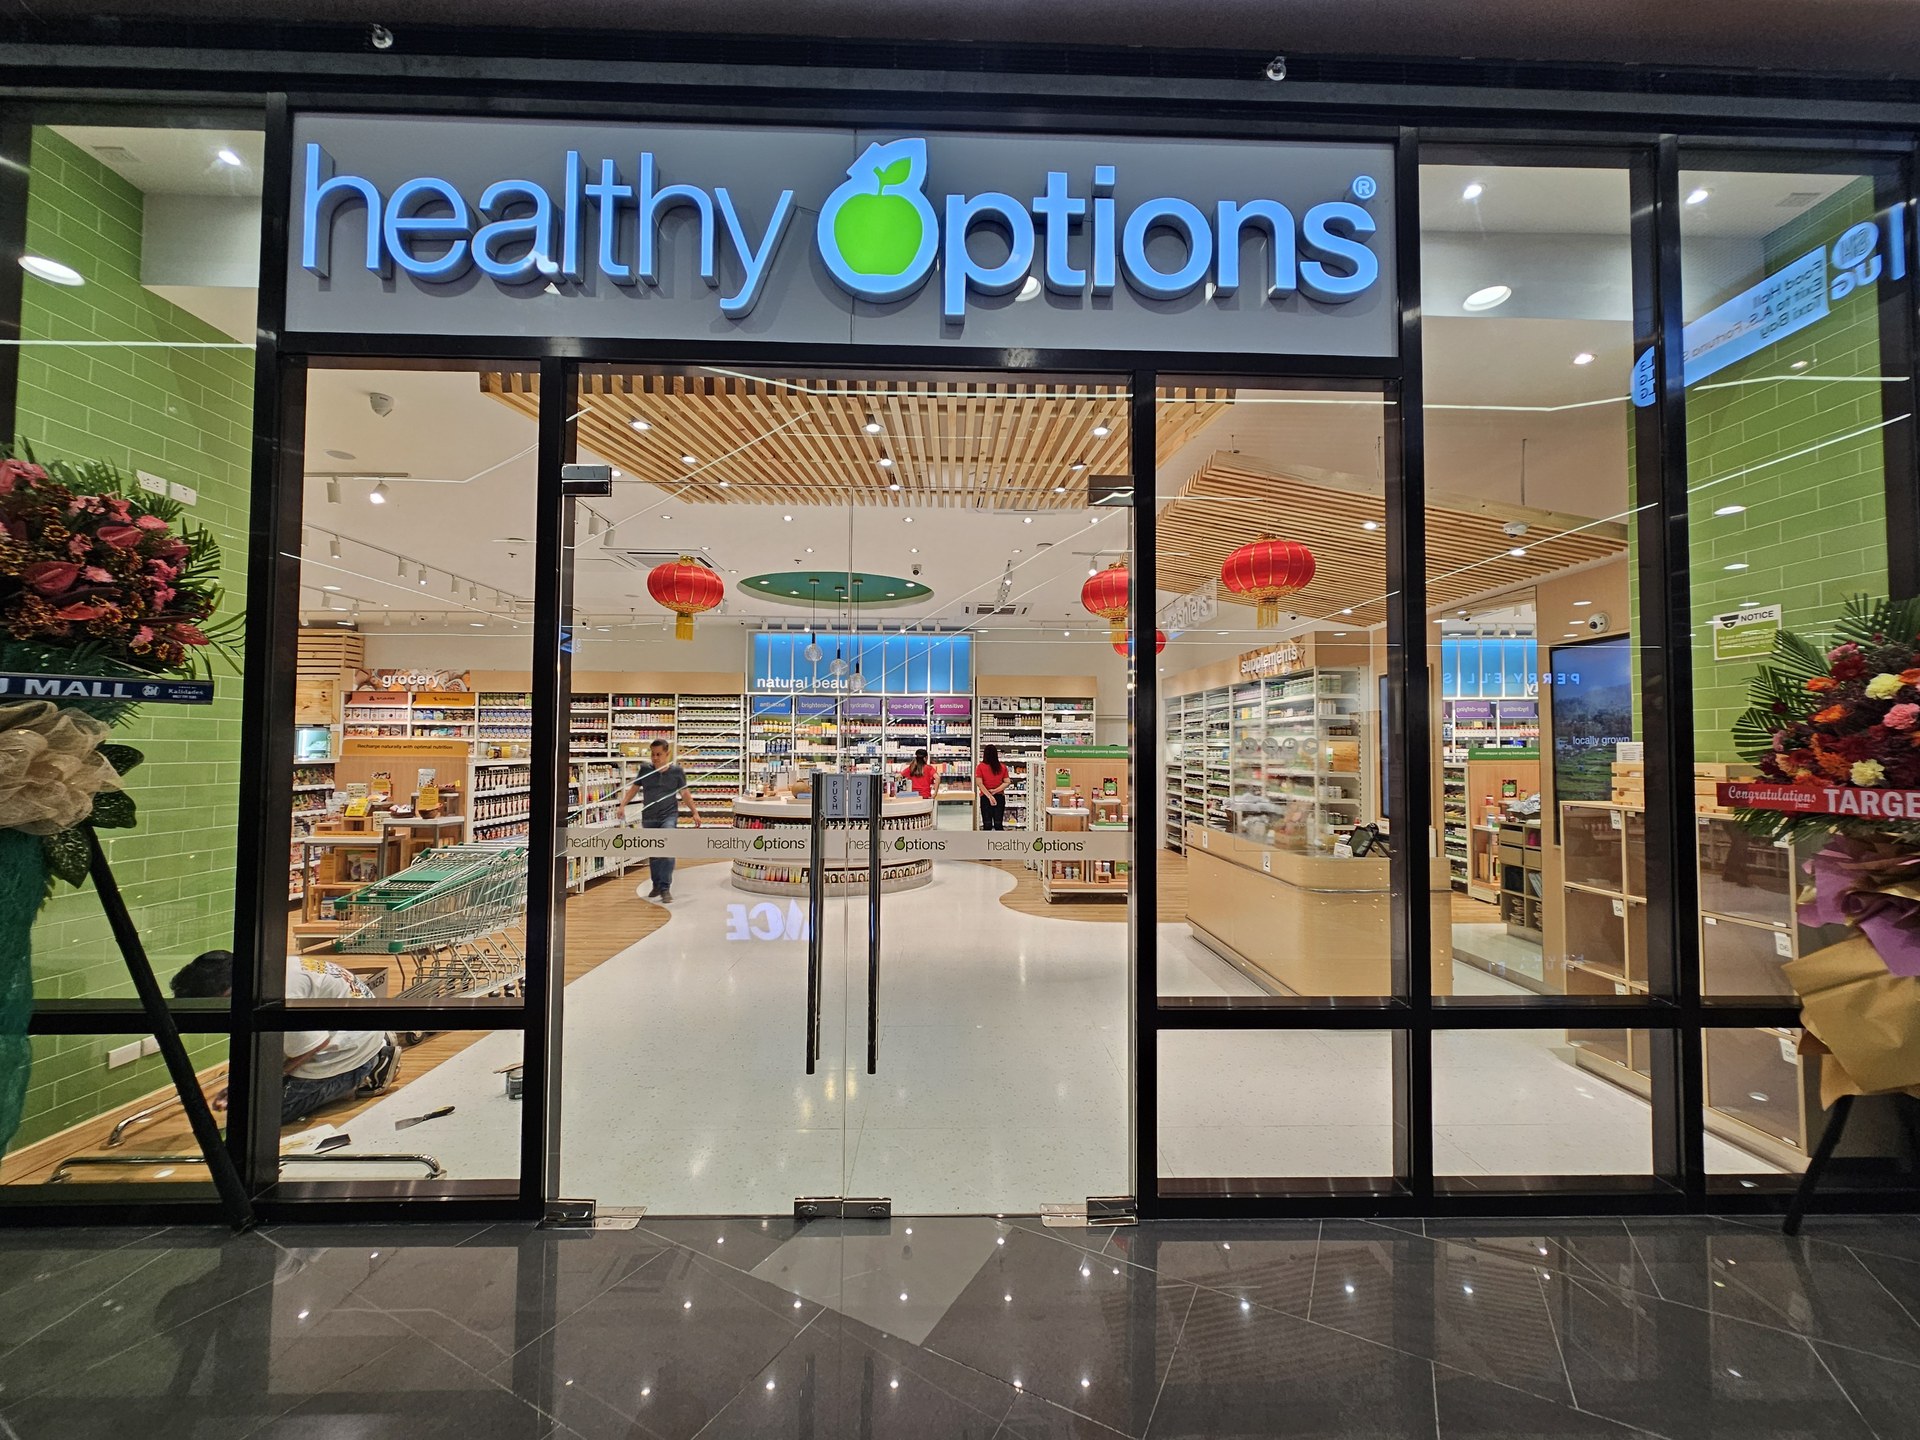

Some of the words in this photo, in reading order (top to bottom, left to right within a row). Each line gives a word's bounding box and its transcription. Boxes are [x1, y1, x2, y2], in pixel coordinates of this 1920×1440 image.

[301, 142, 795, 319] healthy
[1740, 610, 1774, 622] NOTICE
[1240, 645, 1298, 673] supplements
[24, 679, 132, 698] MALL
[382, 674, 440, 688] grocery
[757, 676, 808, 689] natural
[812, 676, 848, 689] beau
[890, 702, 923, 710] age-defying
[1572, 736, 1600, 745] locally
[1728, 785, 1817, 804] Congratulations
[565, 834, 610, 851] healthy
[707, 836, 751, 852] healthy
[987, 838, 1031, 854] healthy
